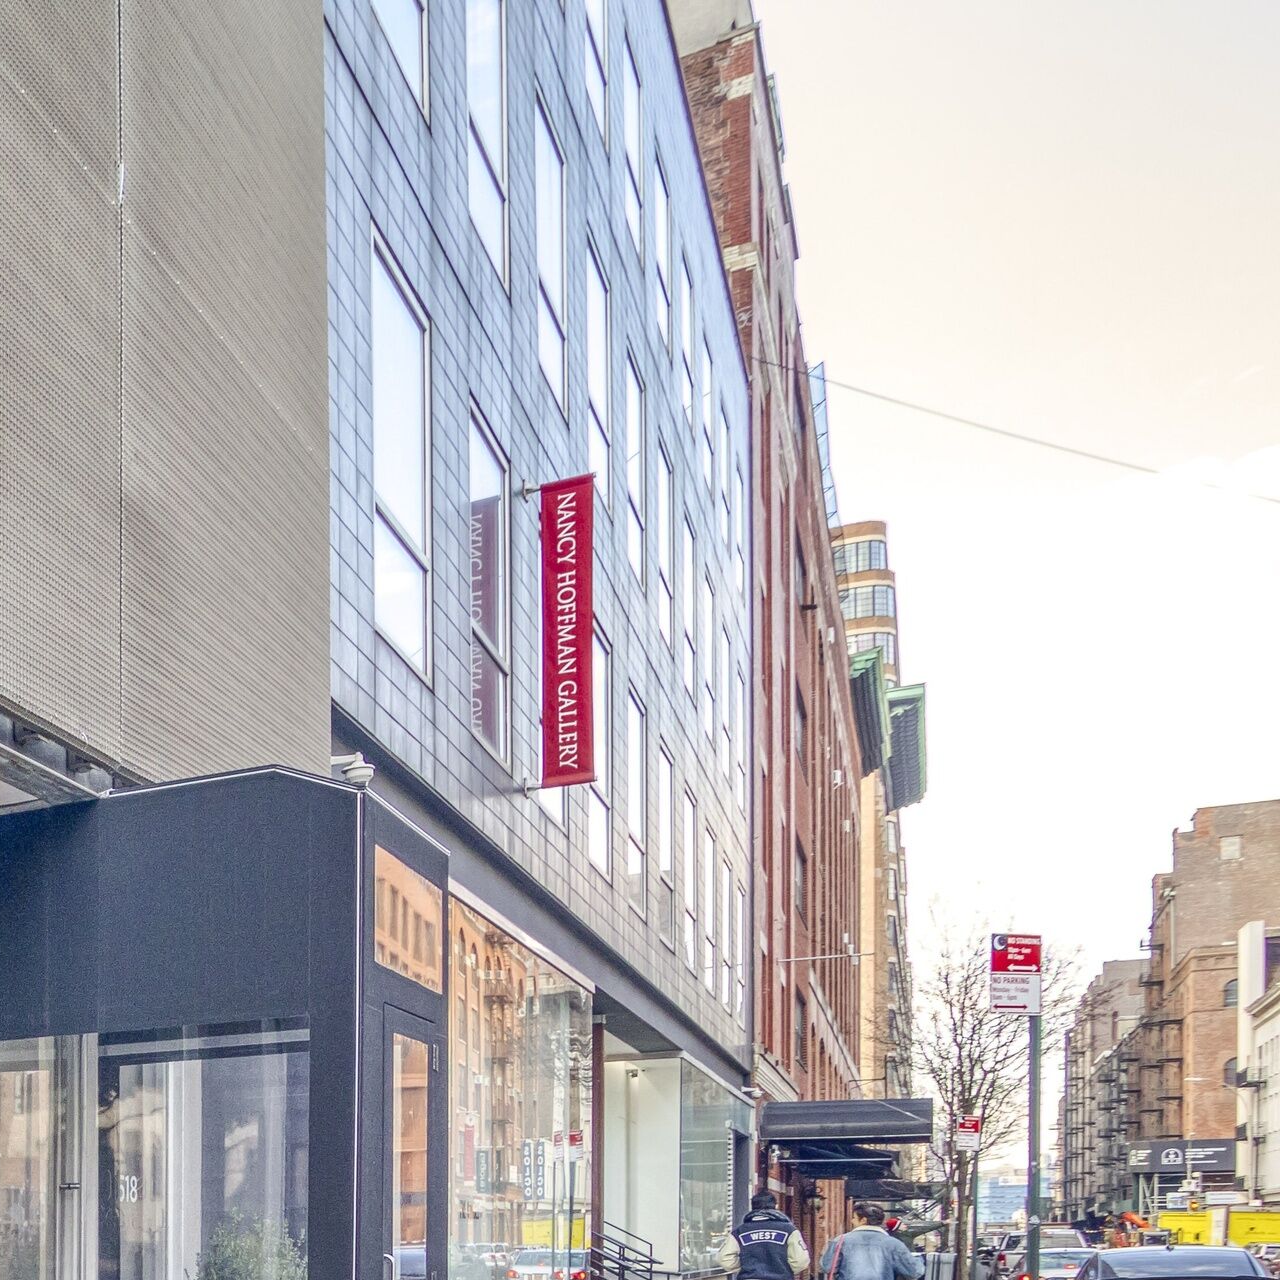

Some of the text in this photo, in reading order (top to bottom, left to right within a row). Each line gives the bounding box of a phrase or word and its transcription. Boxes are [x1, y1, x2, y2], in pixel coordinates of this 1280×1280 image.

[557, 492, 578, 769] NANCY HOFFMAN GALLERY
[1003, 977, 1030, 985] PARKING
[119, 1174, 137, 1203] 518
[750, 1231, 777, 1240] WEST
